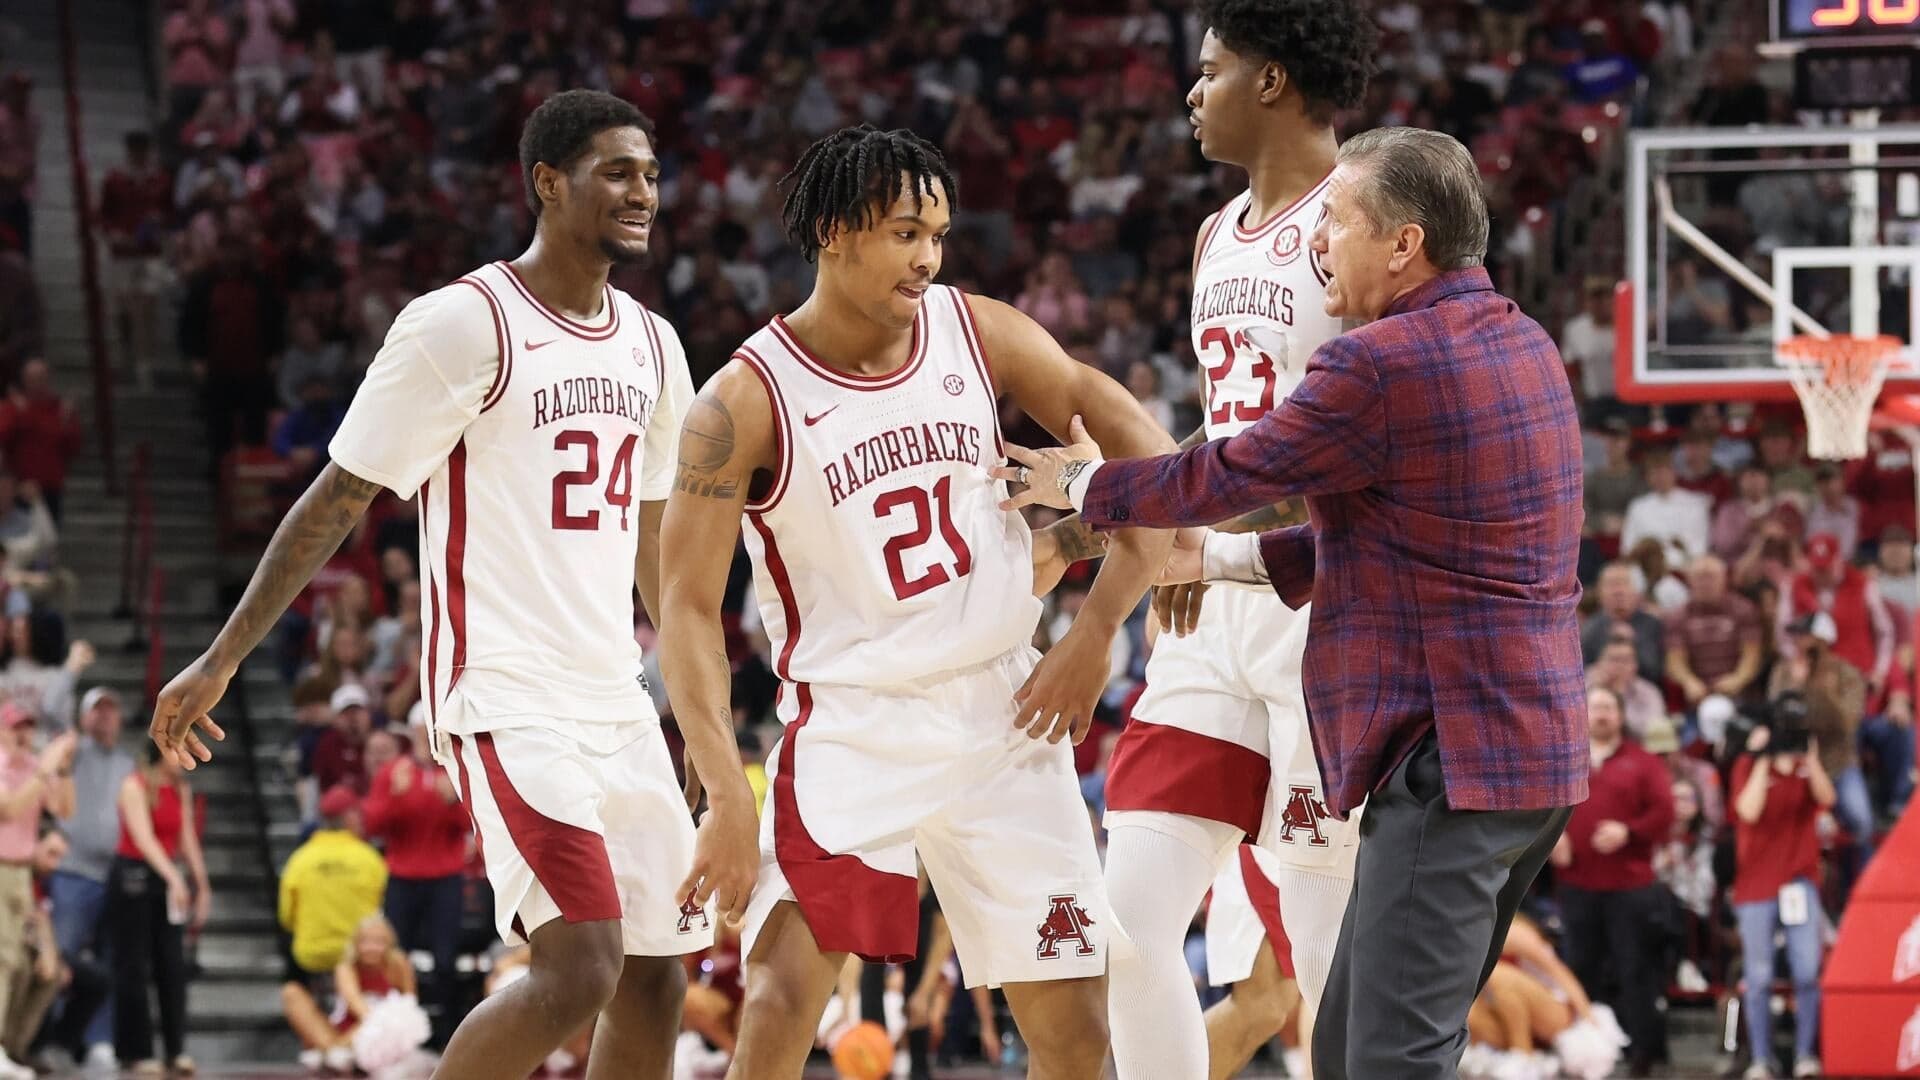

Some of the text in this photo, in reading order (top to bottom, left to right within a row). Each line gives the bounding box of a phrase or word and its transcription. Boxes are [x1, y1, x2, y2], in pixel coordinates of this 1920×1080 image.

[1200, 327, 1276, 425] 23
[552, 430, 639, 531] 24
[823, 422, 980, 507] RAZORBACKS
[873, 475, 972, 602] 21
